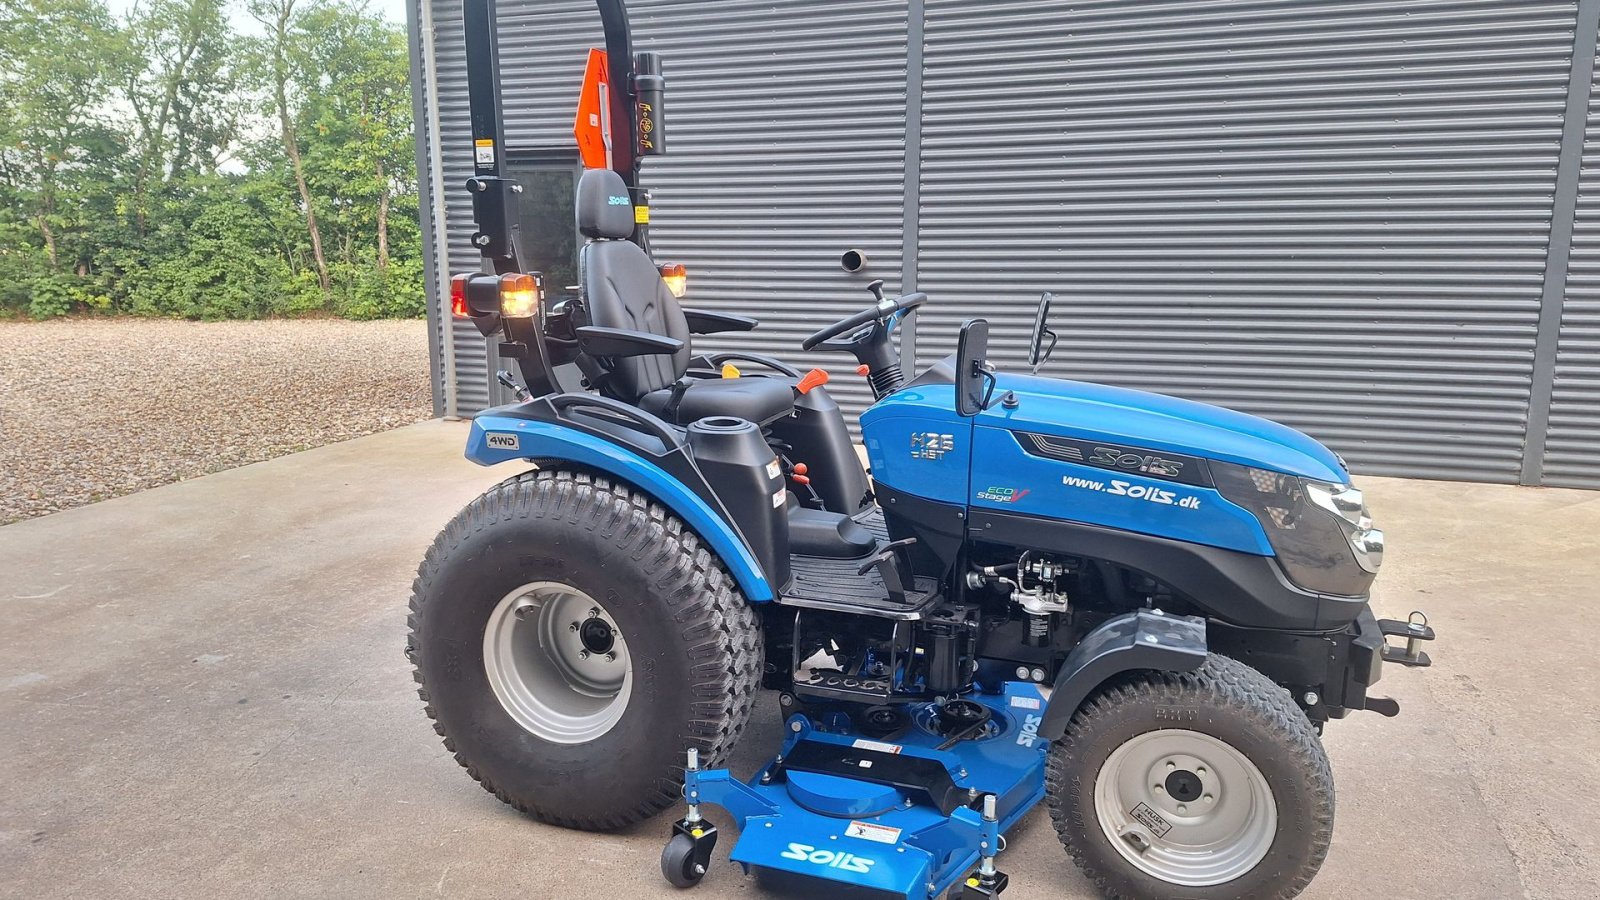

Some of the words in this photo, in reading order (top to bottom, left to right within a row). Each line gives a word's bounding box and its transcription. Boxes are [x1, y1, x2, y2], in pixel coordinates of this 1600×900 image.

[489, 436, 516, 446] 4WD
[910, 432, 954, 450] H26
[987, 486, 1014, 495] ECO
[1144, 808, 1165, 826] HUSK
